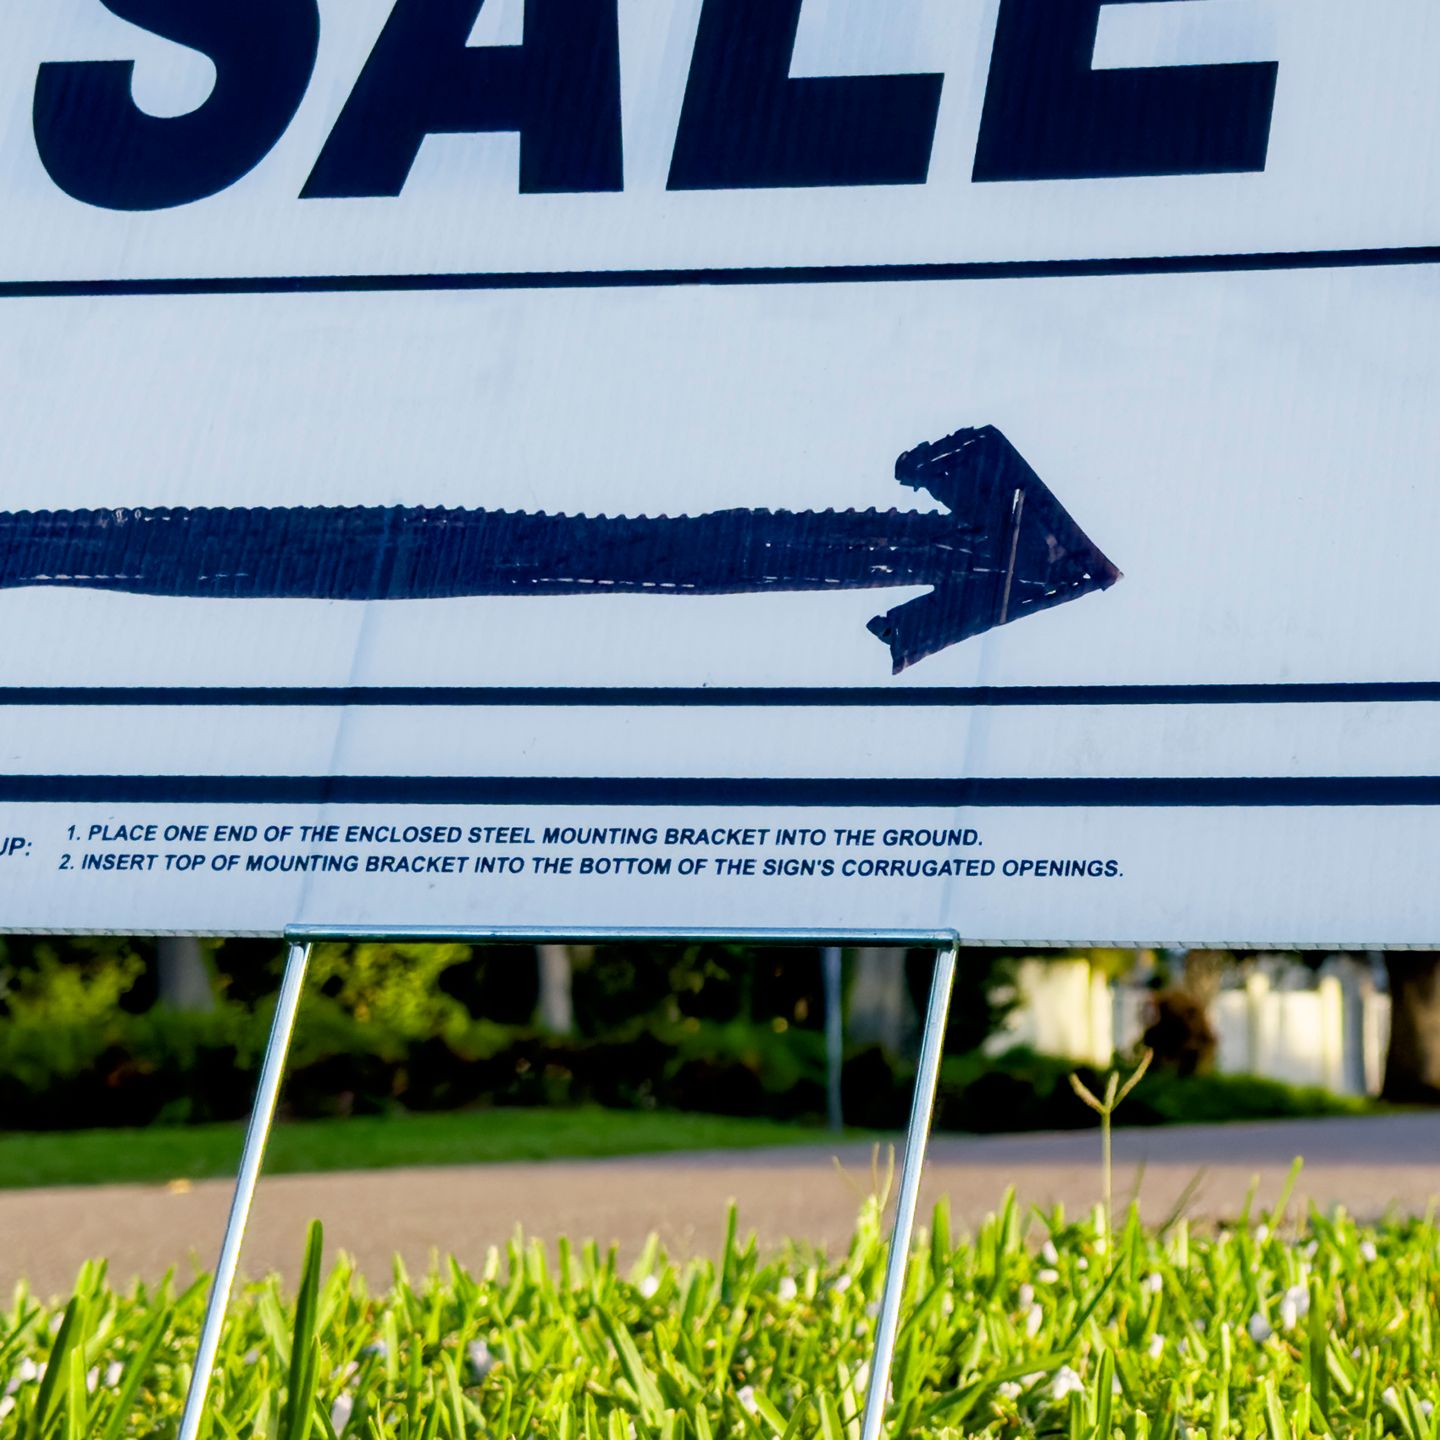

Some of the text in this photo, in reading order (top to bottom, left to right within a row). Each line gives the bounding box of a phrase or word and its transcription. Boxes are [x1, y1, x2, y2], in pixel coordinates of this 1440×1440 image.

[67, 824, 983, 846] 1. PLACE ONE END OF THE ENCLOSED STEEL MOUNTING BRACKET INTO THE GROUND.
[58, 853, 1125, 877] 2. INSERT TOP OF MOUNTING BRACKET INTO THE BOTTOM OF THE SIGN'S CORRUGATED OPENINGS.
